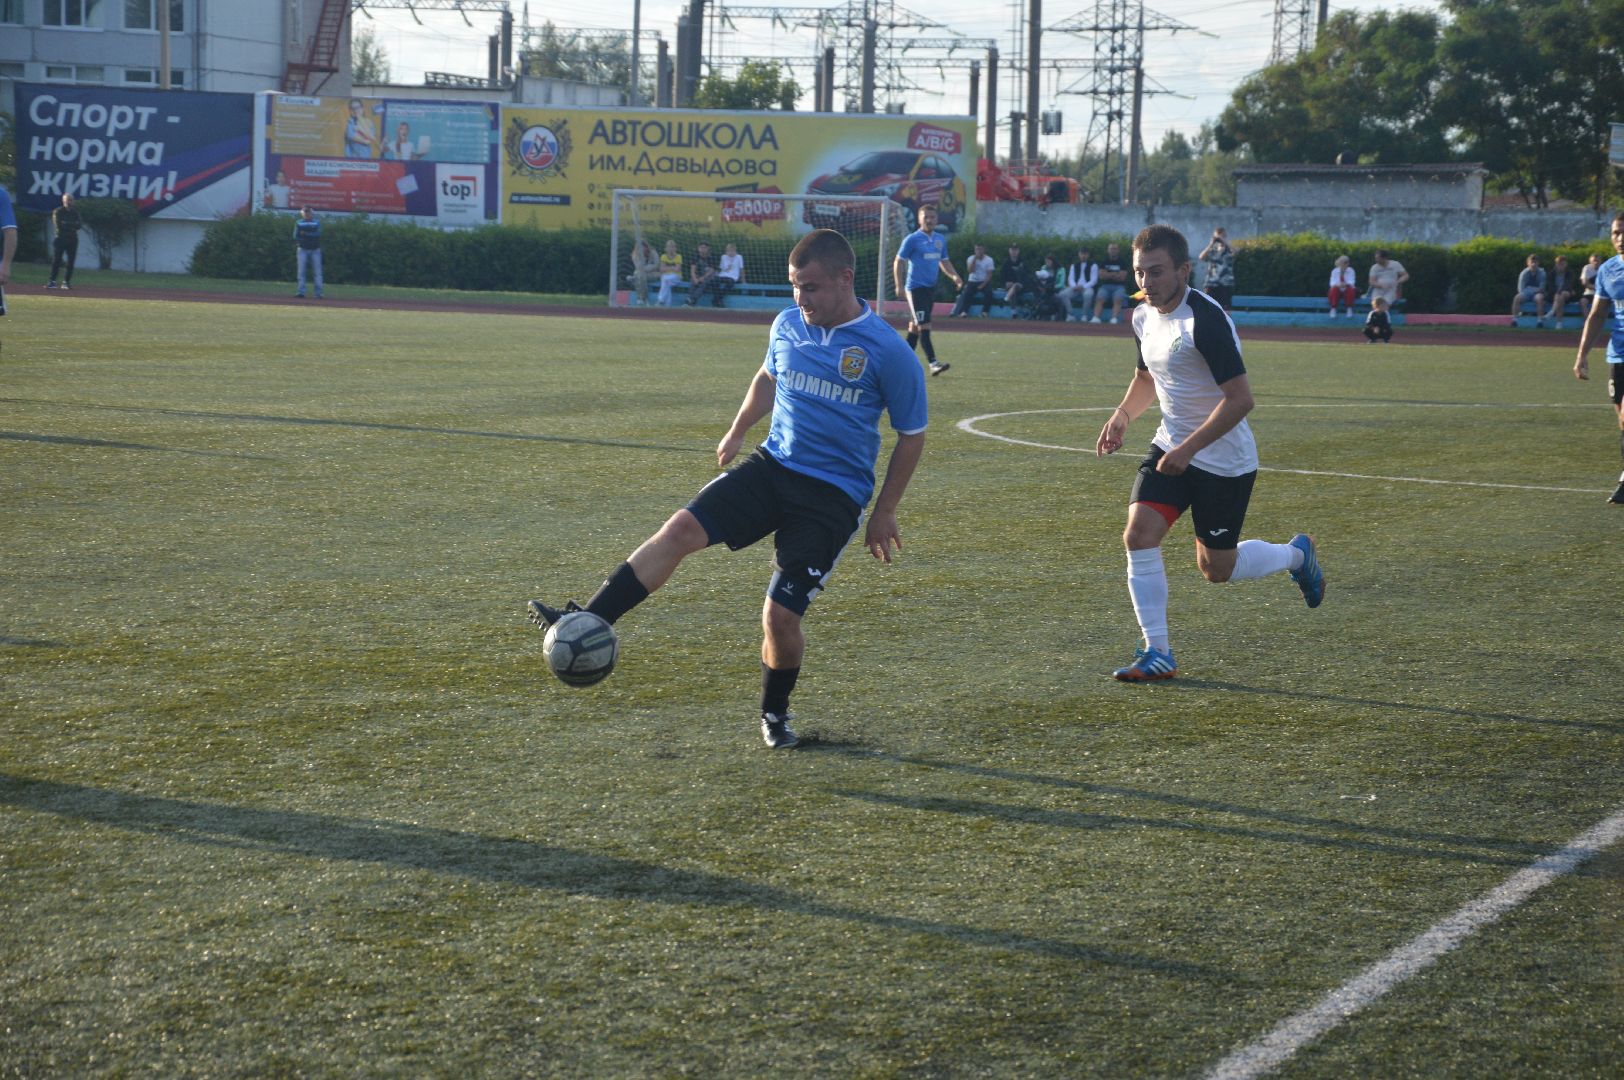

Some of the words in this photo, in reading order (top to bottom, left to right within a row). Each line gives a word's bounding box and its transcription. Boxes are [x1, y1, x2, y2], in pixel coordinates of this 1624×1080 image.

[29, 94, 158, 137] Спорт
[587, 119, 780, 151] АВТОШКОЛА
[29, 135, 164, 170] норма
[28, 170, 178, 201] жизни!
[440, 180, 471, 200] top
[785, 368, 864, 405] КОМПРАГ
